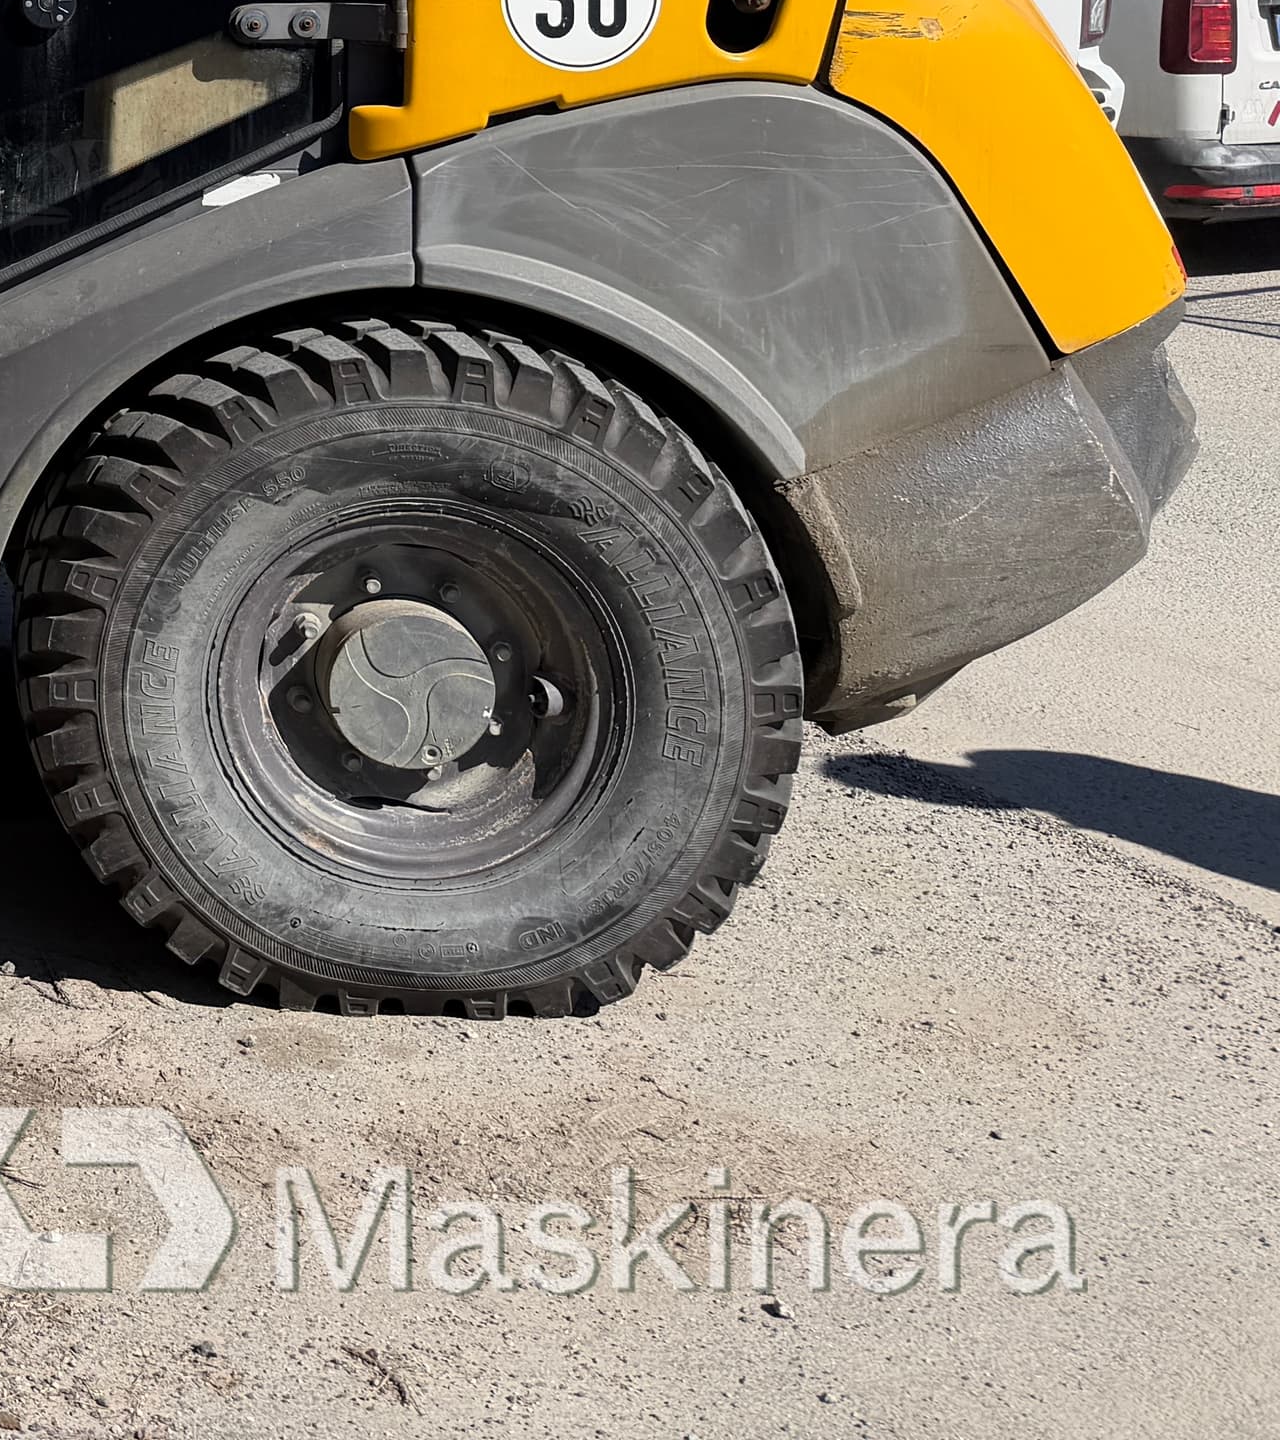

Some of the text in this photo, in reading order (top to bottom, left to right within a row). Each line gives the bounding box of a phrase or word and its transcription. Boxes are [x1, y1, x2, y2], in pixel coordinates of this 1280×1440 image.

[261, 466, 307, 498] 550
[577, 521, 708, 768] ALLIANCE
[140, 639, 259, 878] ALLIANCE
[519, 920, 566, 951] IND
